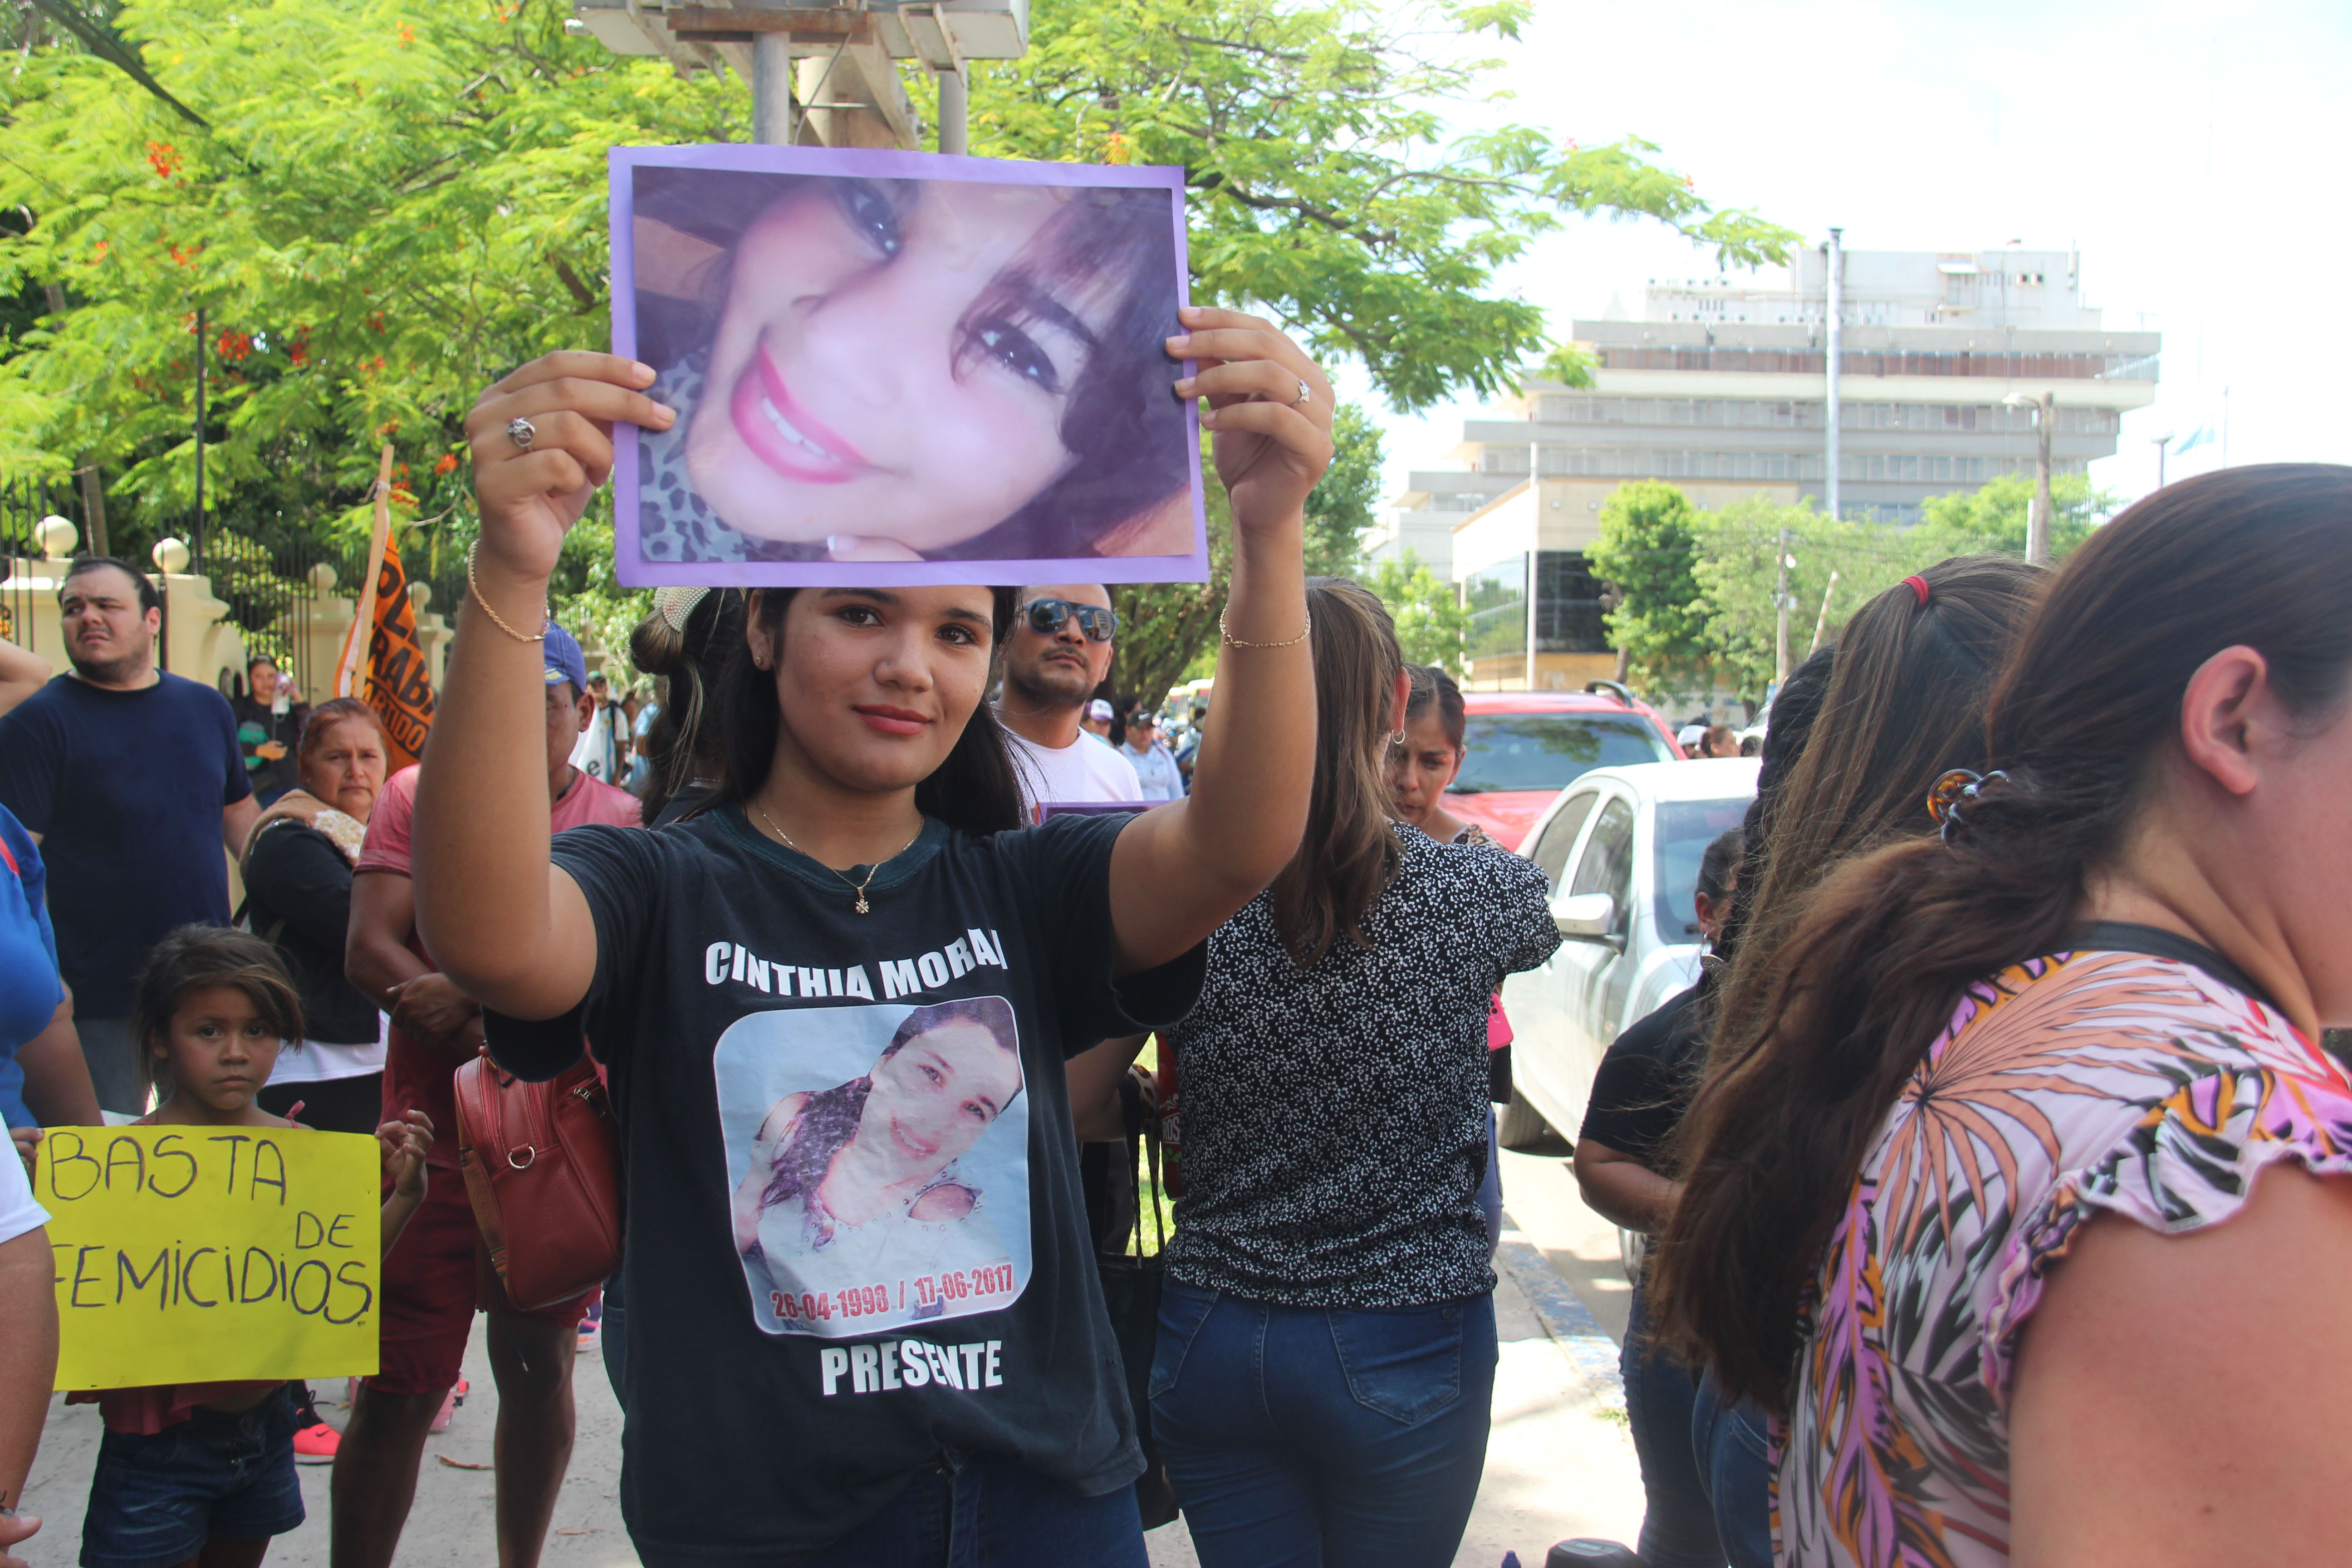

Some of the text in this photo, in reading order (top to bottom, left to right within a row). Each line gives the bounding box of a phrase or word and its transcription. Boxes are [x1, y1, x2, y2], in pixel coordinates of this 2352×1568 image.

[705, 941, 874, 1000] CINTHIA
[49, 1132, 287, 1205] BASTA
[295, 1210, 356, 1250] DE
[914, 1264, 1013, 1306] 17-06-2017
[821, 1339, 1003, 1396] PRESENTE
